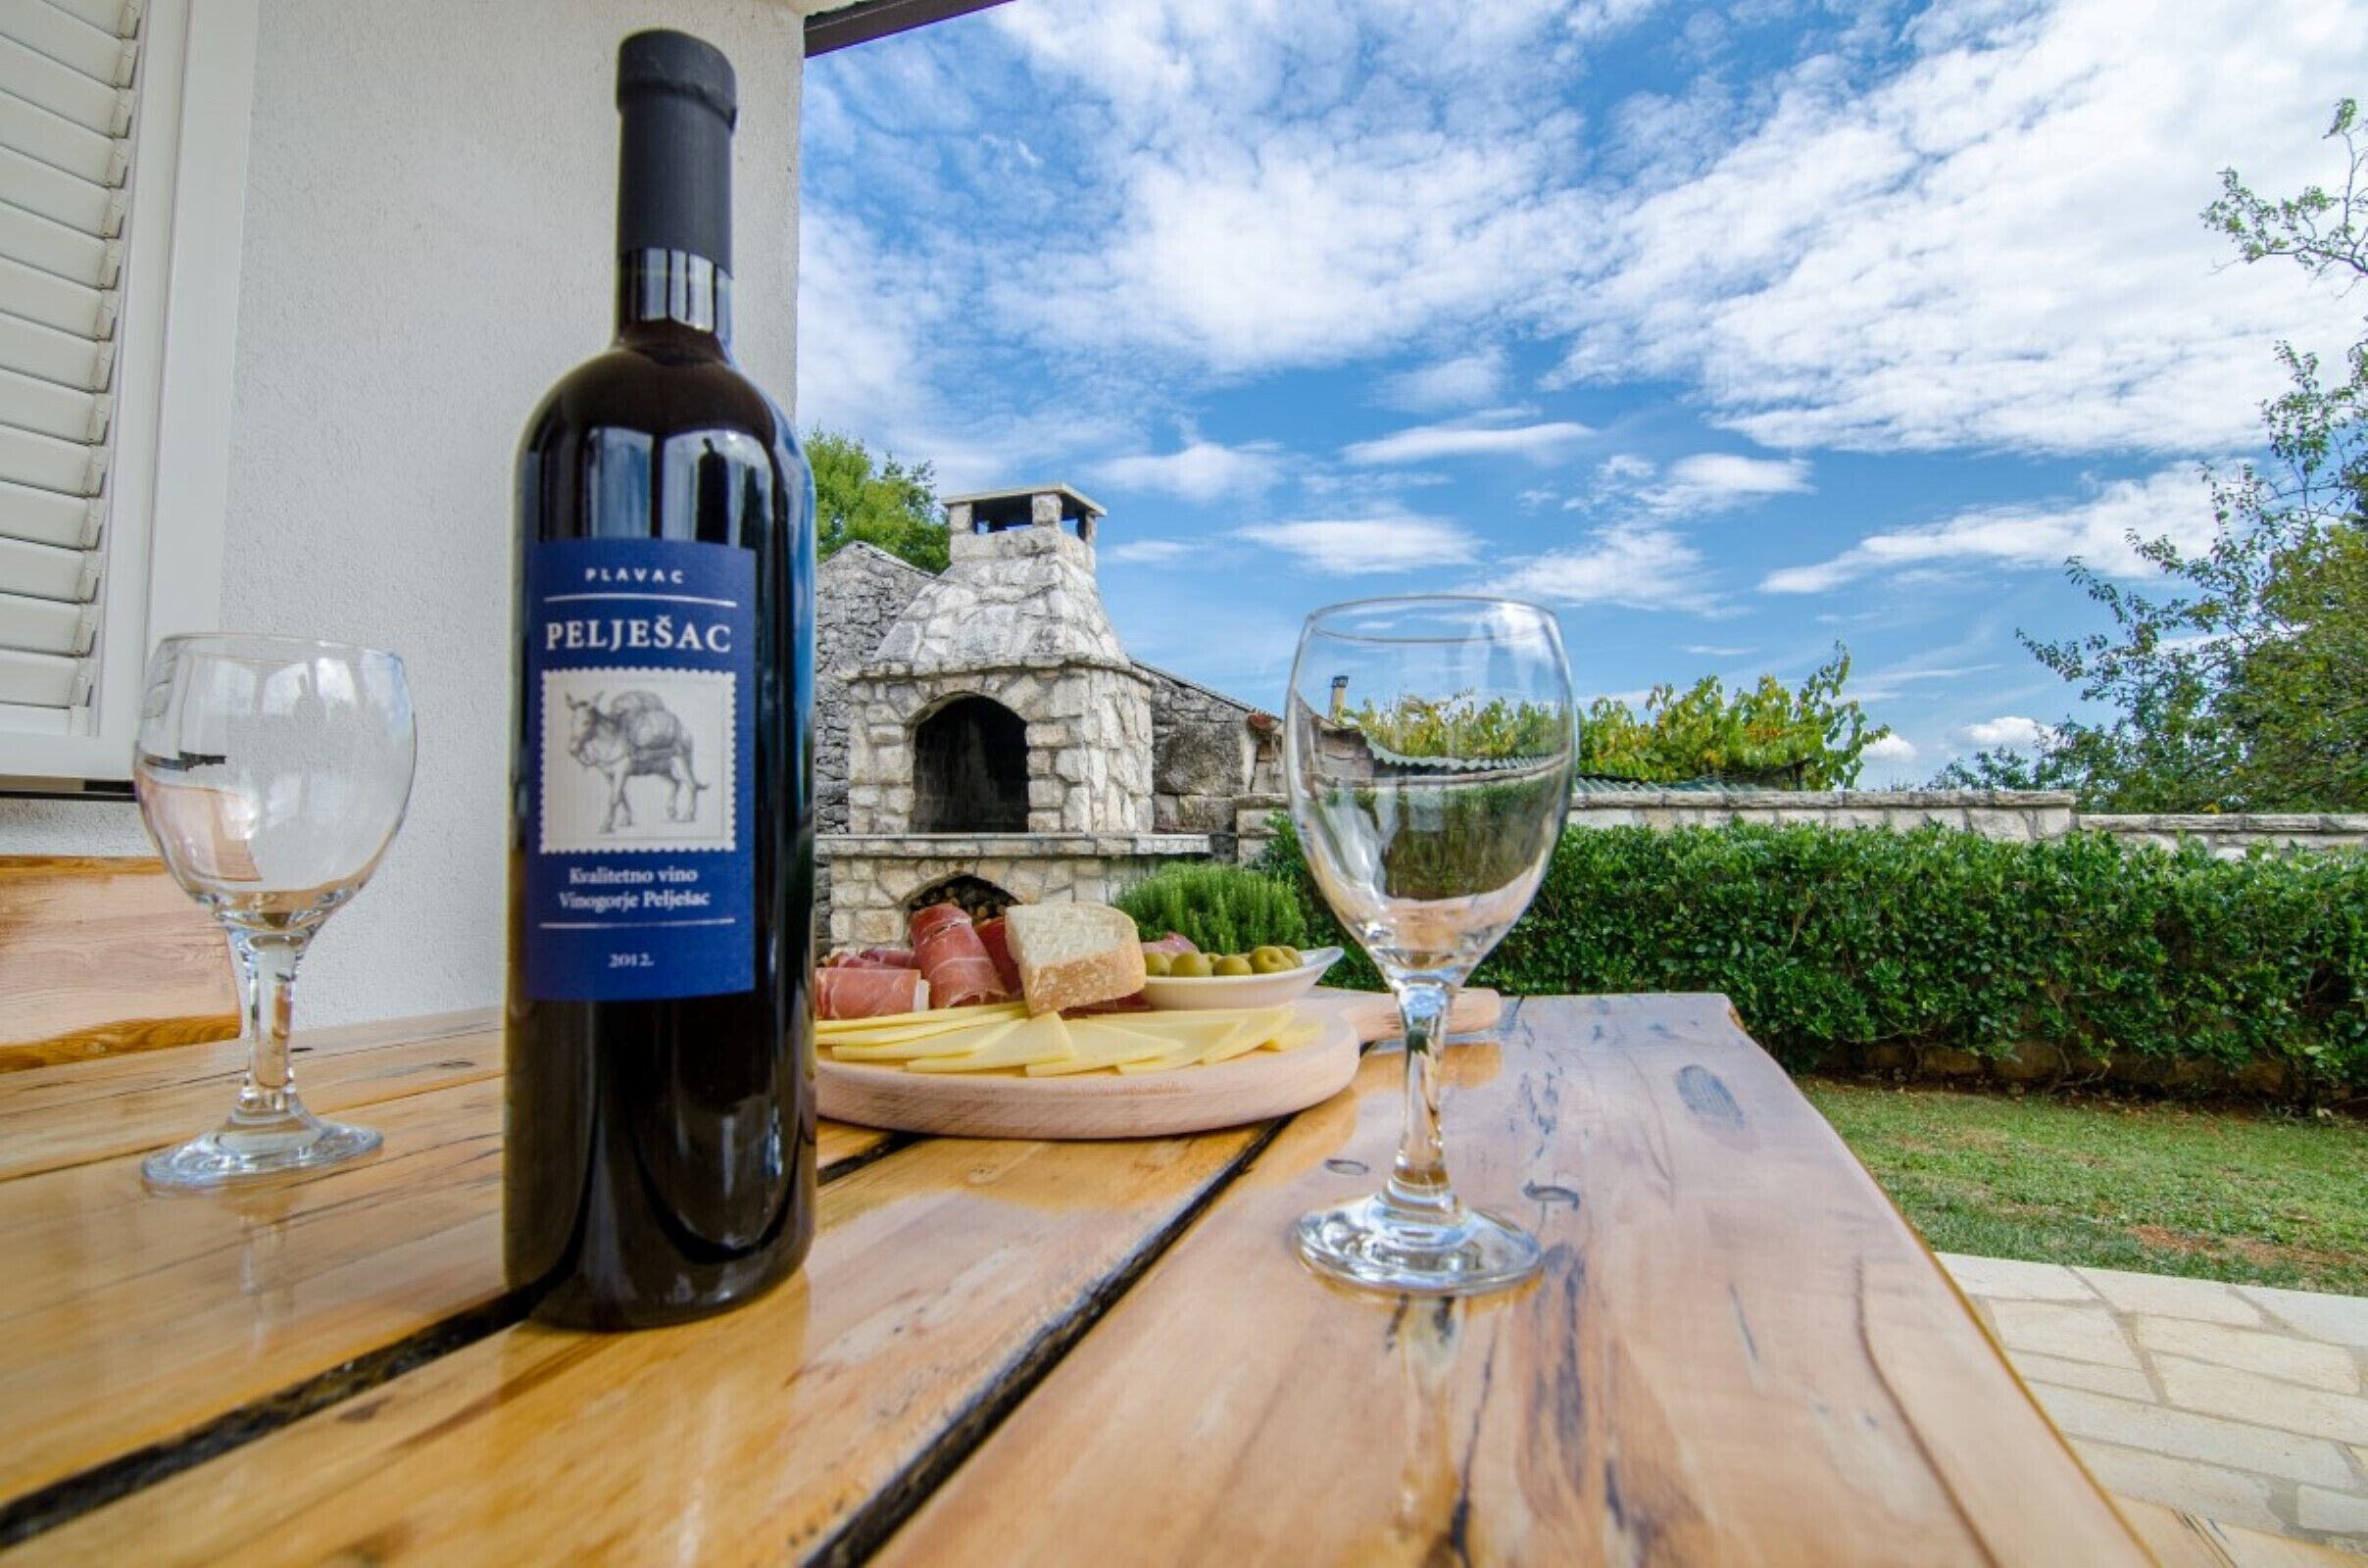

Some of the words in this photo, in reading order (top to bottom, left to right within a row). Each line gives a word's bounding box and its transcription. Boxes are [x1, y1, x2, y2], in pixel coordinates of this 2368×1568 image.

[585, 568, 683, 583] PLAVAC
[546, 614, 731, 653] PELJEŠAC
[658, 865, 699, 882] vino
[559, 891, 639, 913] Vinogorje
